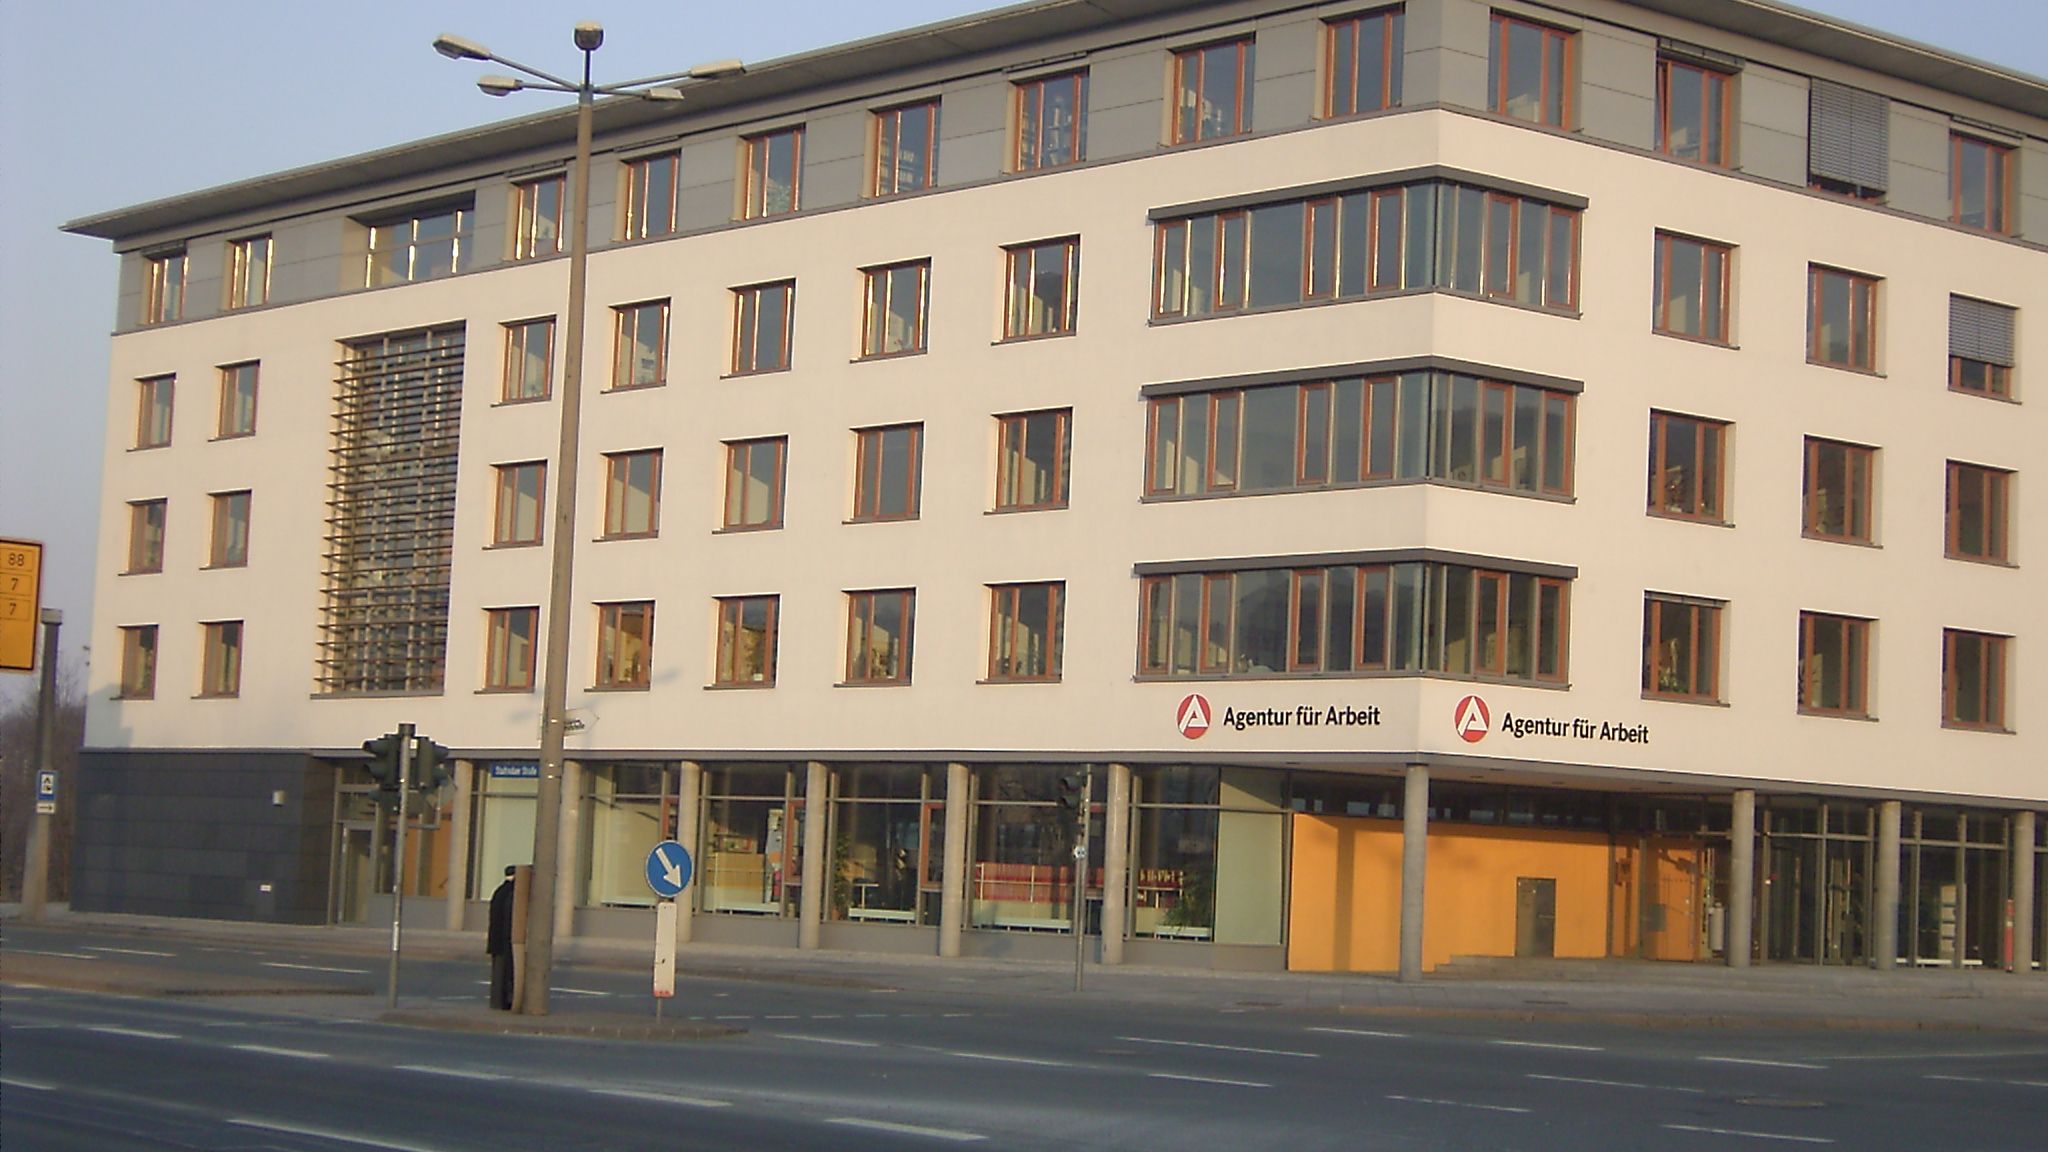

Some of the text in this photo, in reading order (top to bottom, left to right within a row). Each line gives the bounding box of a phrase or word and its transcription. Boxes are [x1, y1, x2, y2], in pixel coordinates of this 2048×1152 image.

[8, 552, 24, 566] 88
[11, 577, 18, 591] 7
[9, 602, 16, 615] 7
[1223, 705, 1381, 731] Agentur für Arbeit
[1501, 712, 1649, 744] Agentur für Arbeit
